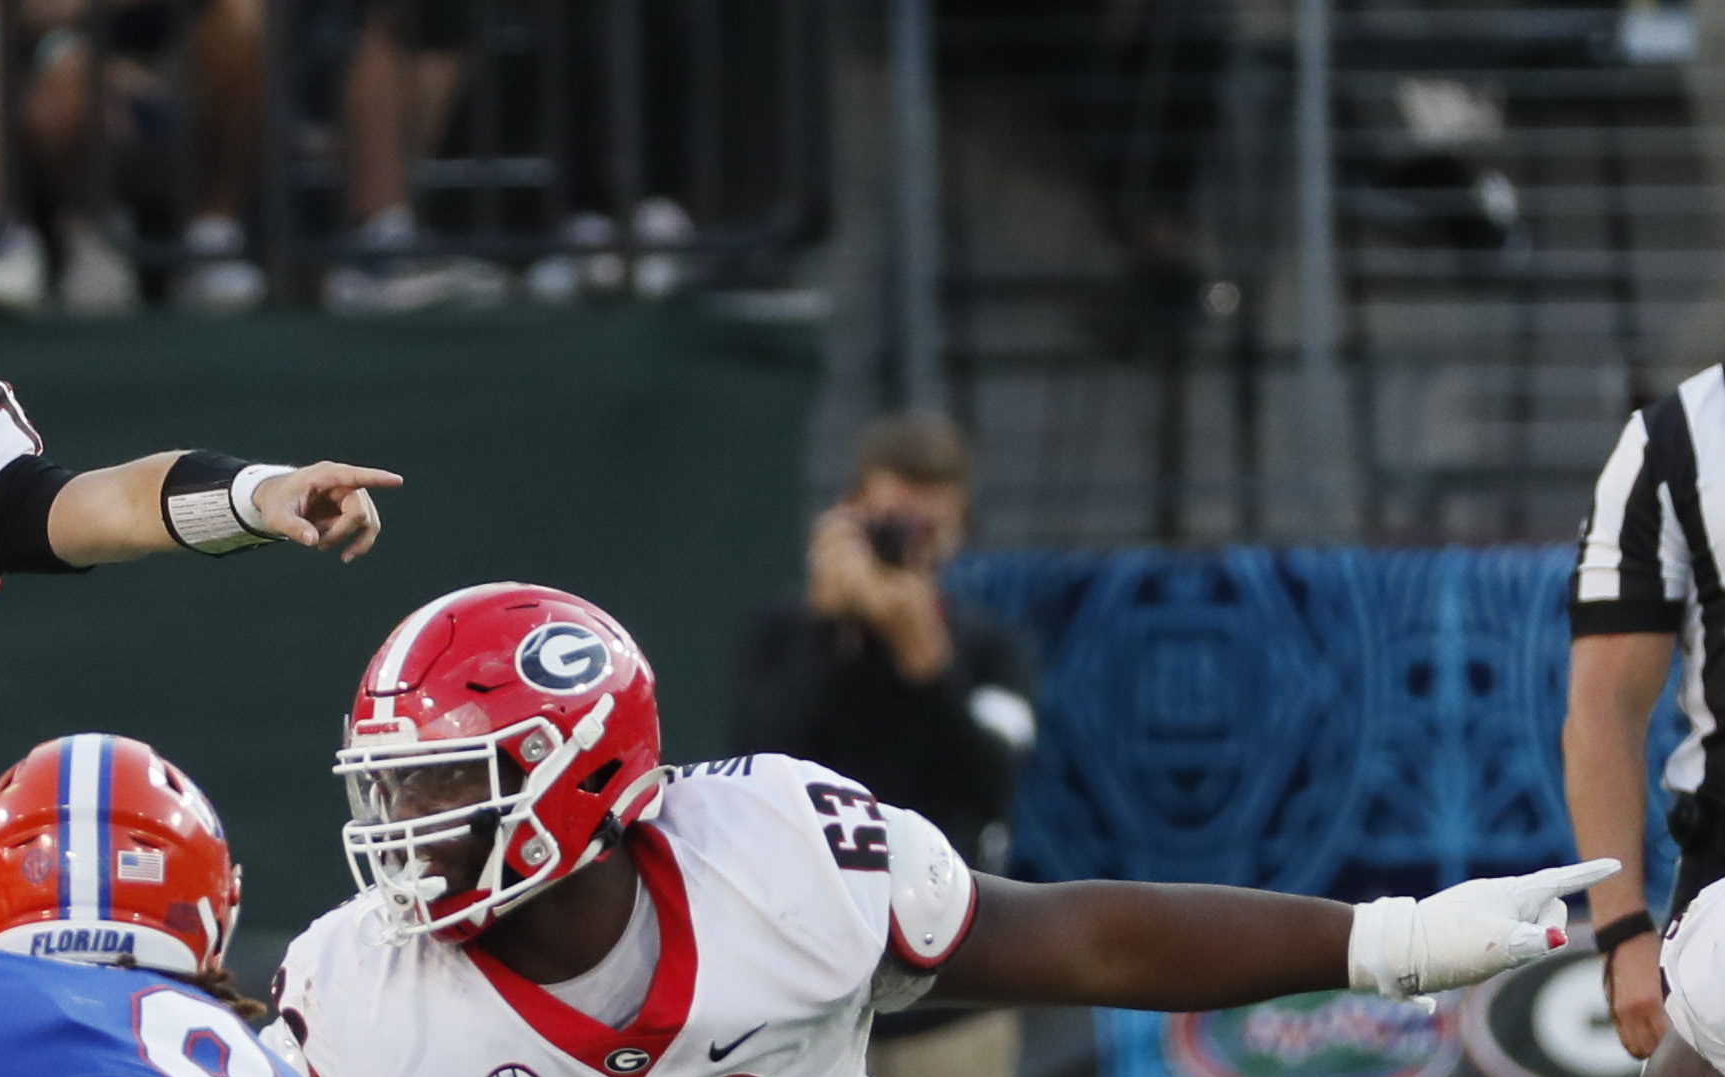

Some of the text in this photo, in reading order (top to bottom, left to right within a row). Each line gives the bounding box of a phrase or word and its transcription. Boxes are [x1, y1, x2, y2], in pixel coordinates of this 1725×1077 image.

[526, 627, 607, 687] G
[31, 929, 135, 956] FLORIDA
[609, 1049, 649, 1072] G
